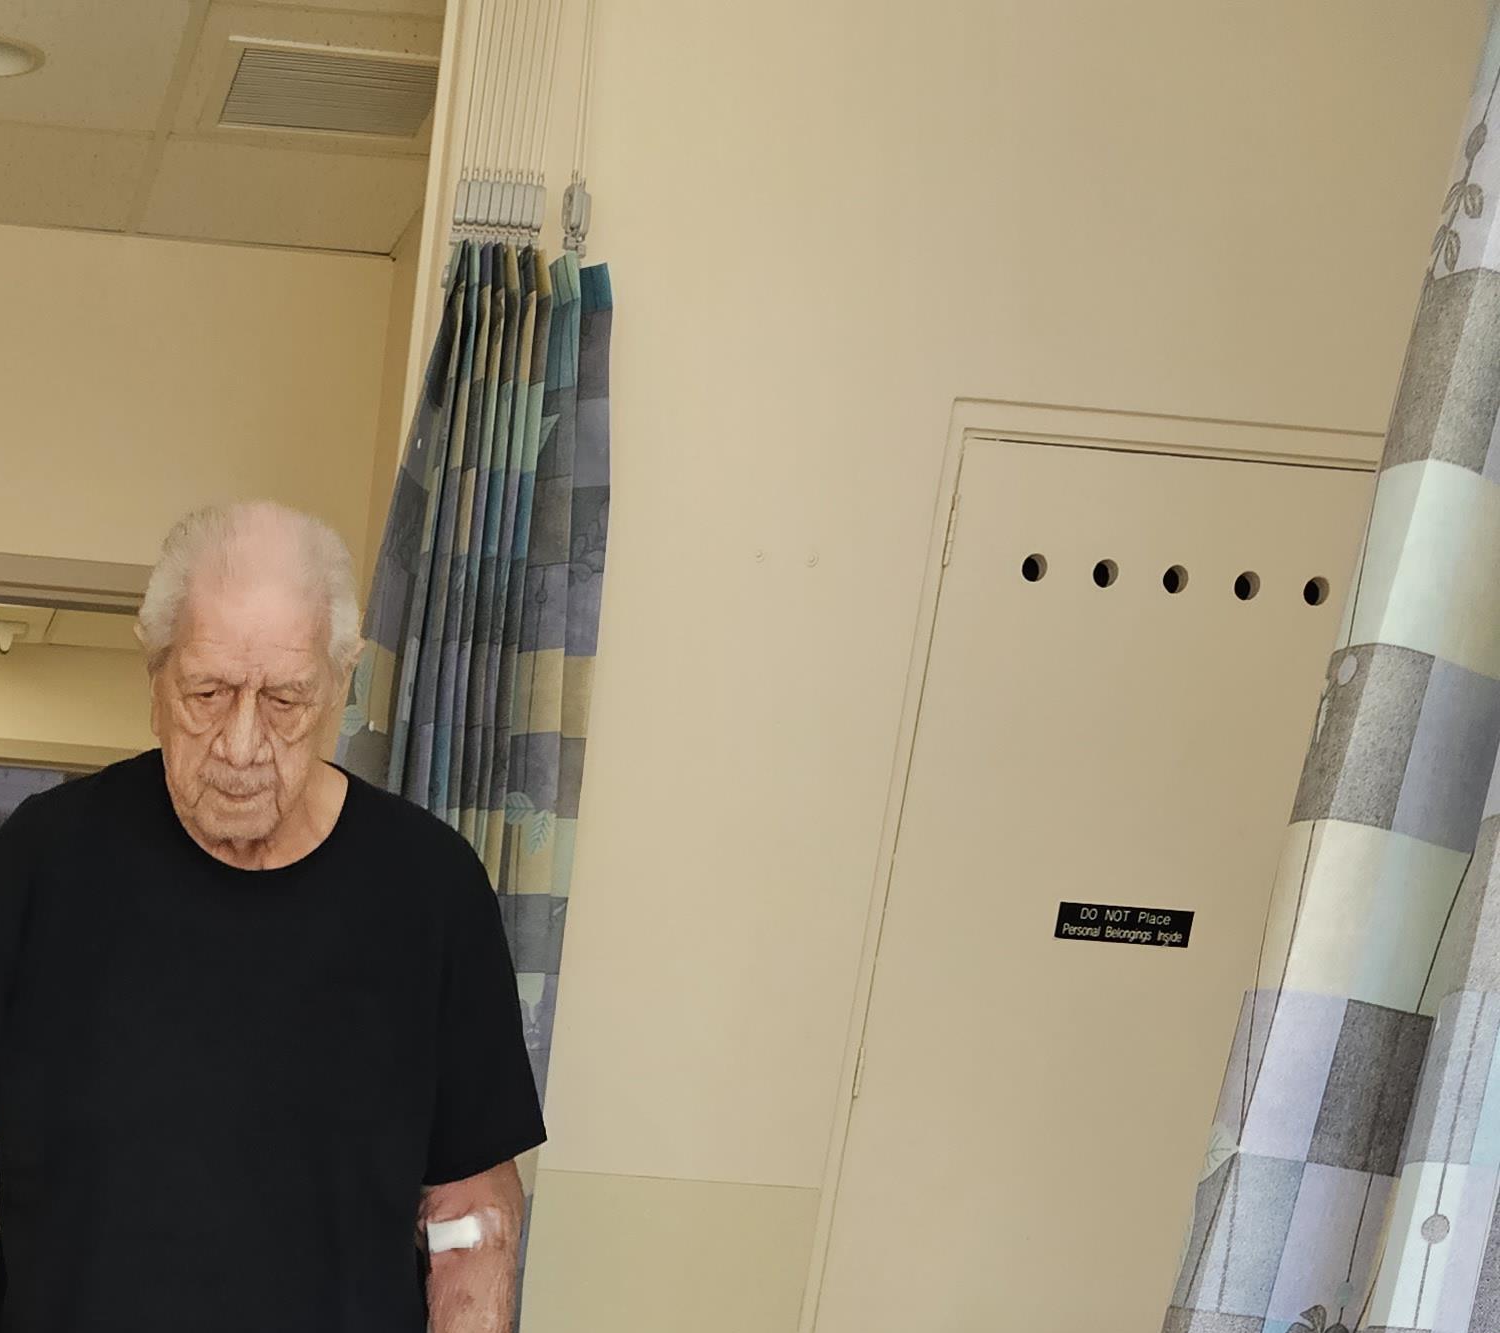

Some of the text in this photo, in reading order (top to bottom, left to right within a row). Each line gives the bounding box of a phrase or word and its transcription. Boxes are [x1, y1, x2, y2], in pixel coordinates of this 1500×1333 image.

[1080, 907, 1172, 926] DO NOT Place
[1062, 922, 1183, 944] Personal Belongings Inside
